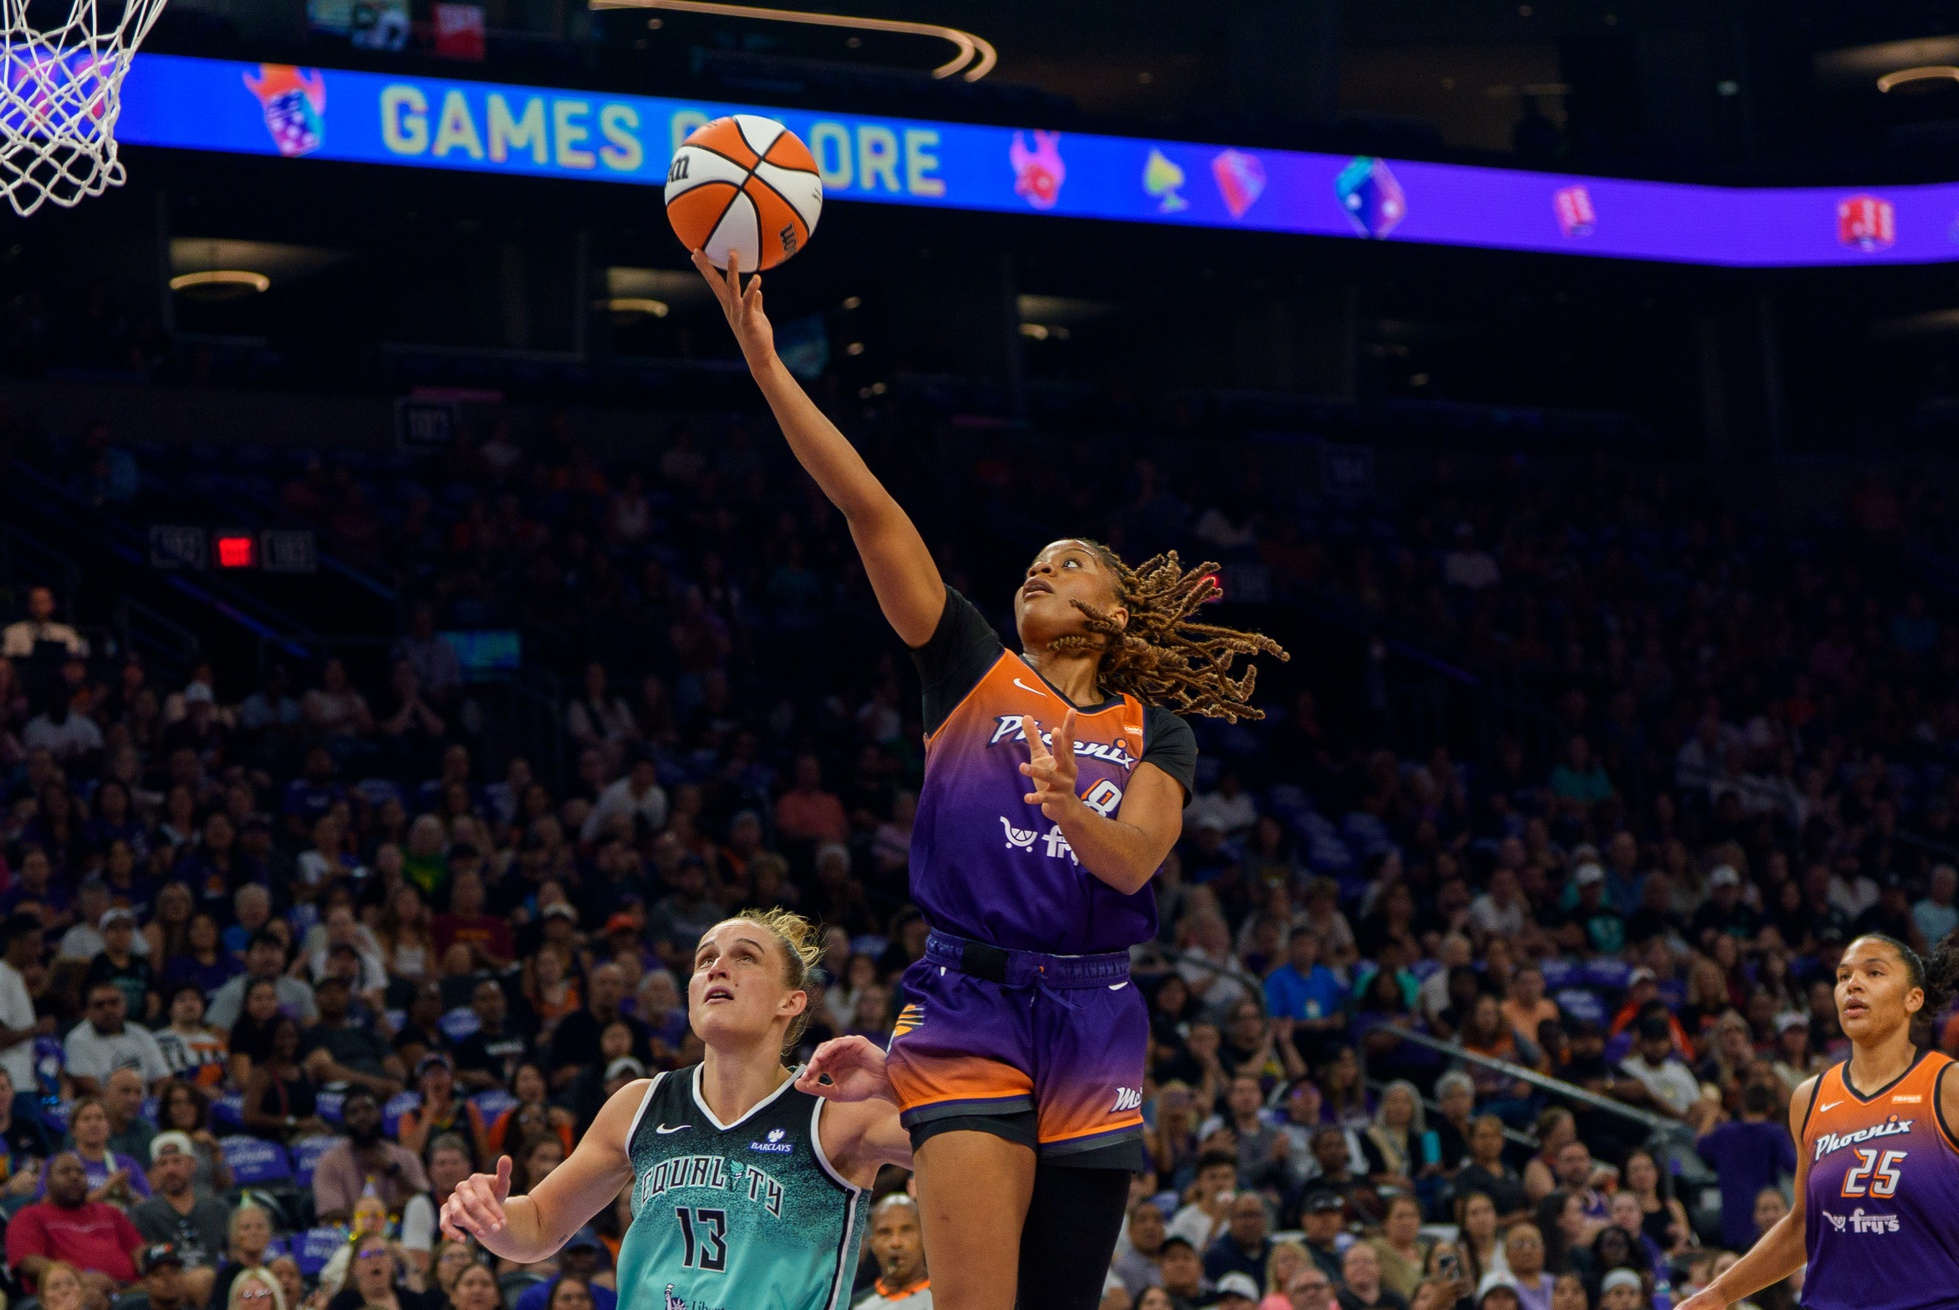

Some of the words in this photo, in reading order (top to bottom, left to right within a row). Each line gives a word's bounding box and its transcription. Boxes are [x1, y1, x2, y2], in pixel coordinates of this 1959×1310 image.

[380, 84, 643, 170] GAMES
[669, 110, 946, 197] ORE
[750, 1141, 792, 1152] BARCLAYS
[1814, 1114, 1914, 1162] Phoenix
[1841, 1148, 1908, 1199] 25
[675, 1206, 728, 1274] 13
[1849, 1208, 1900, 1235] fry's
